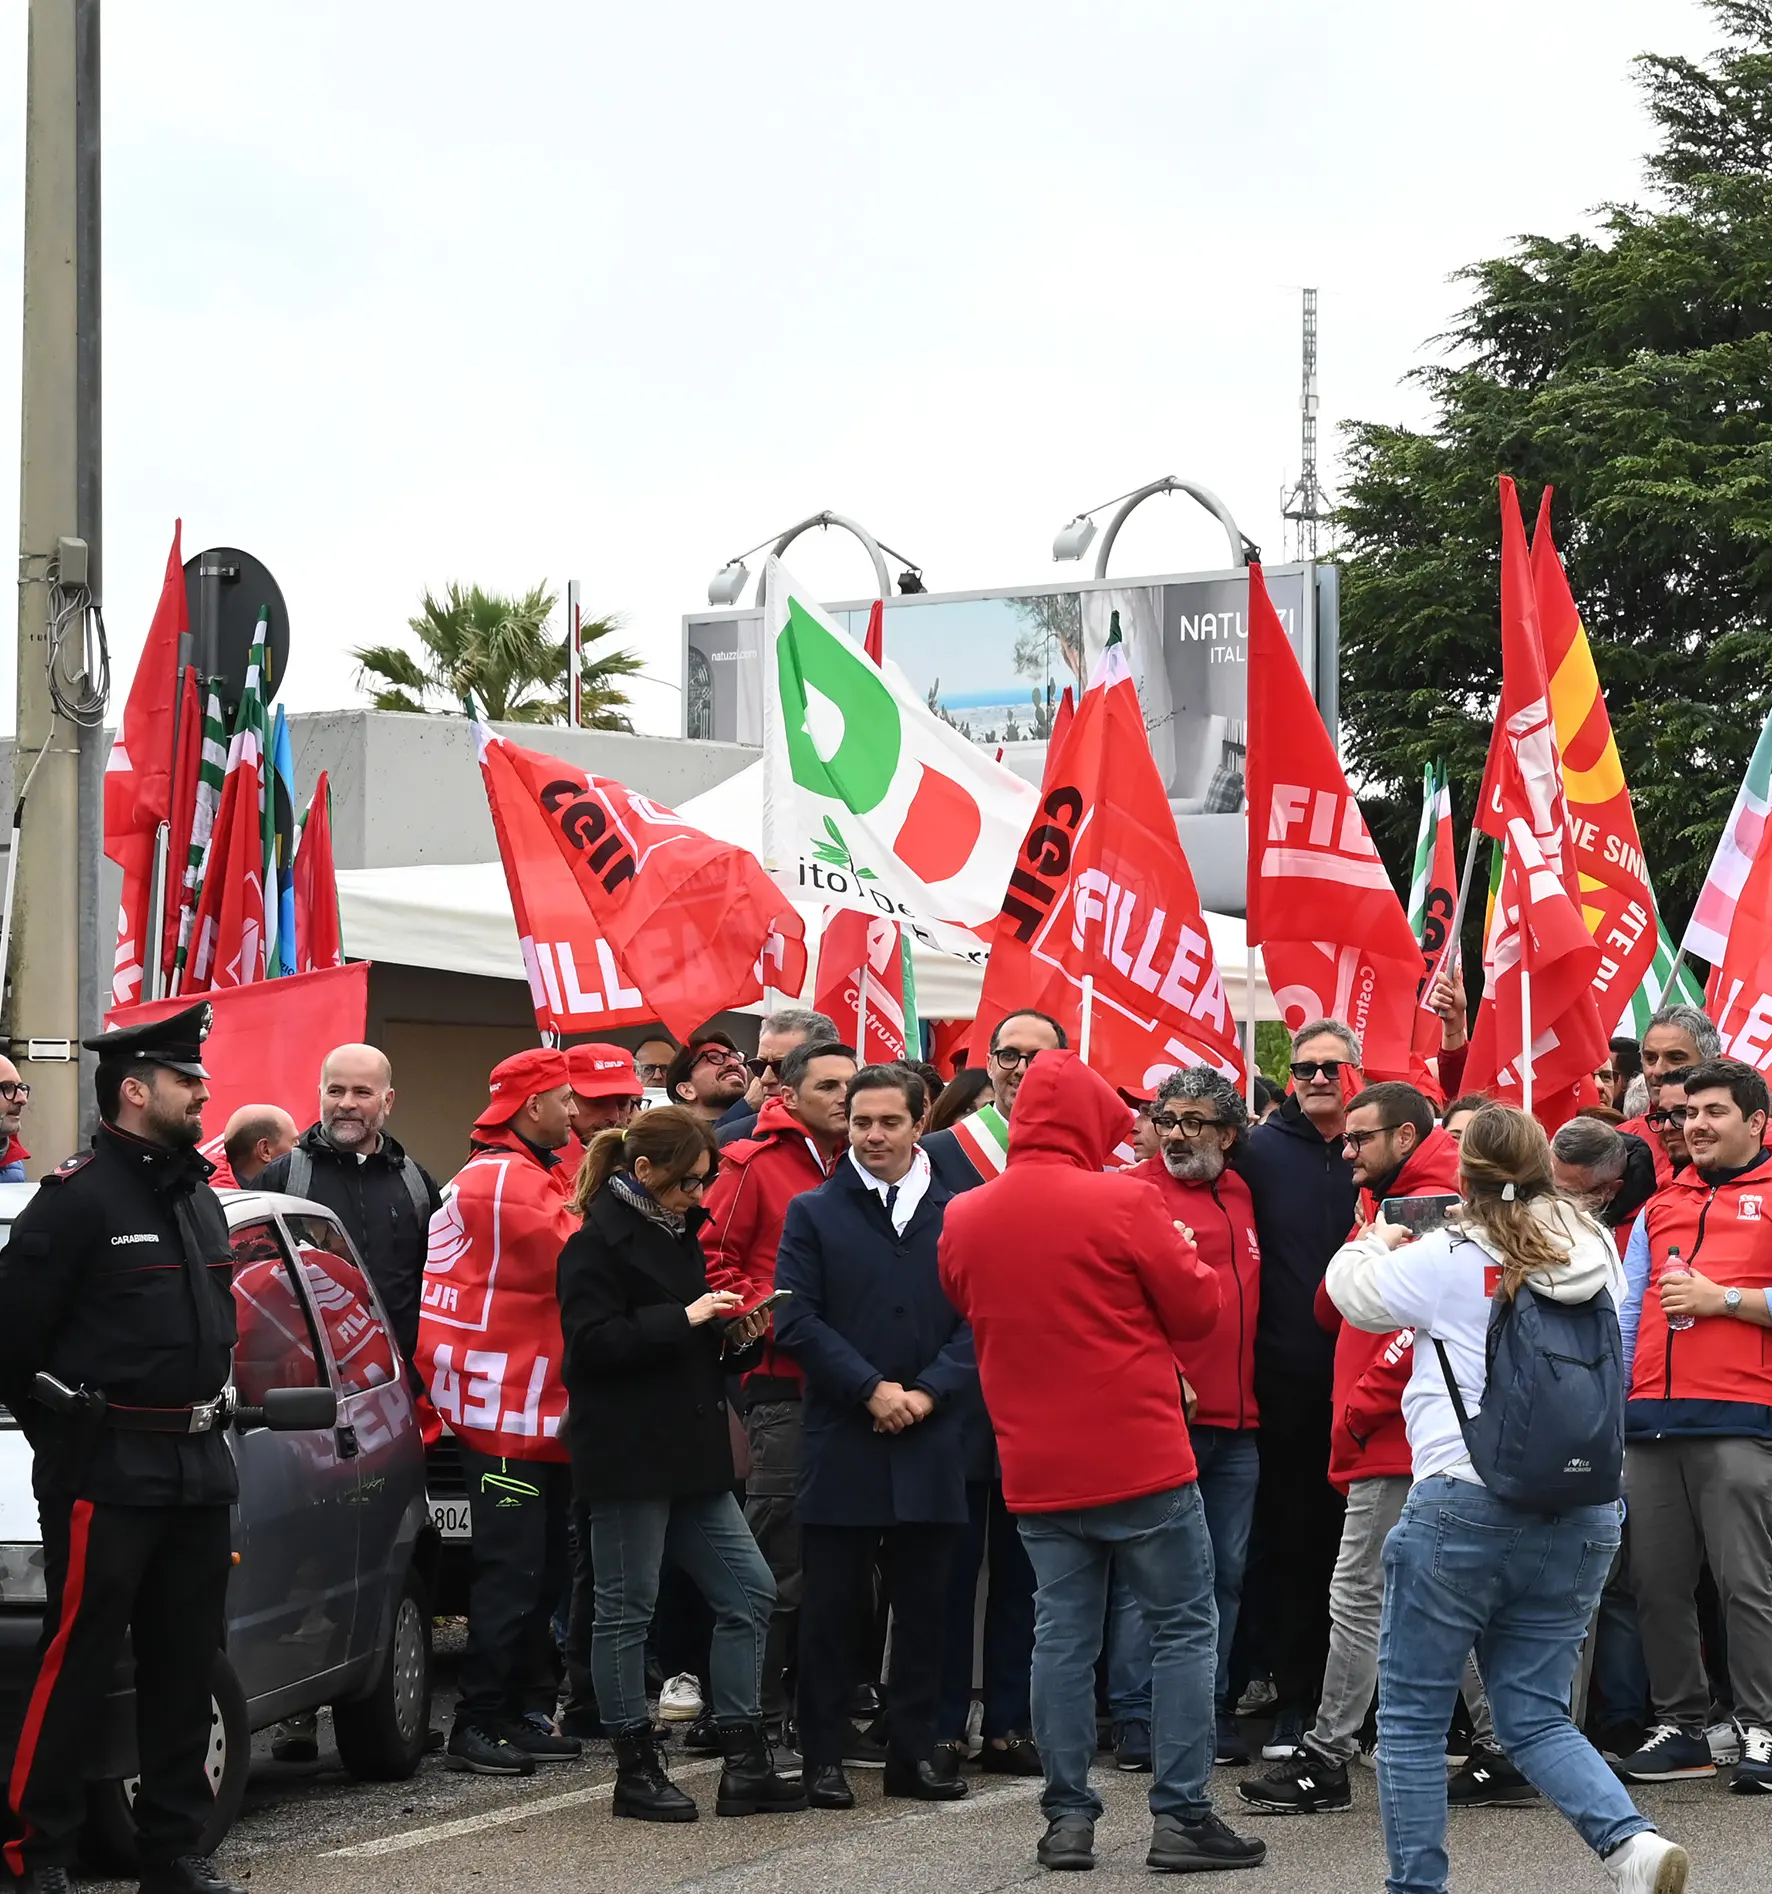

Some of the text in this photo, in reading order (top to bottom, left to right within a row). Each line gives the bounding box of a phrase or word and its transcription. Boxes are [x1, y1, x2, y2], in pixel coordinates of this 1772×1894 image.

[1180, 608, 1294, 641] NATUZI
[711, 650, 758, 662] natuzzi.com
[1210, 645, 1246, 664] ITAL
[1267, 783, 1376, 856] FIL
[1001, 786, 1083, 944] CGIL
[1071, 867, 1227, 1034] FILLEA
[434, 1507, 468, 1531] 804
